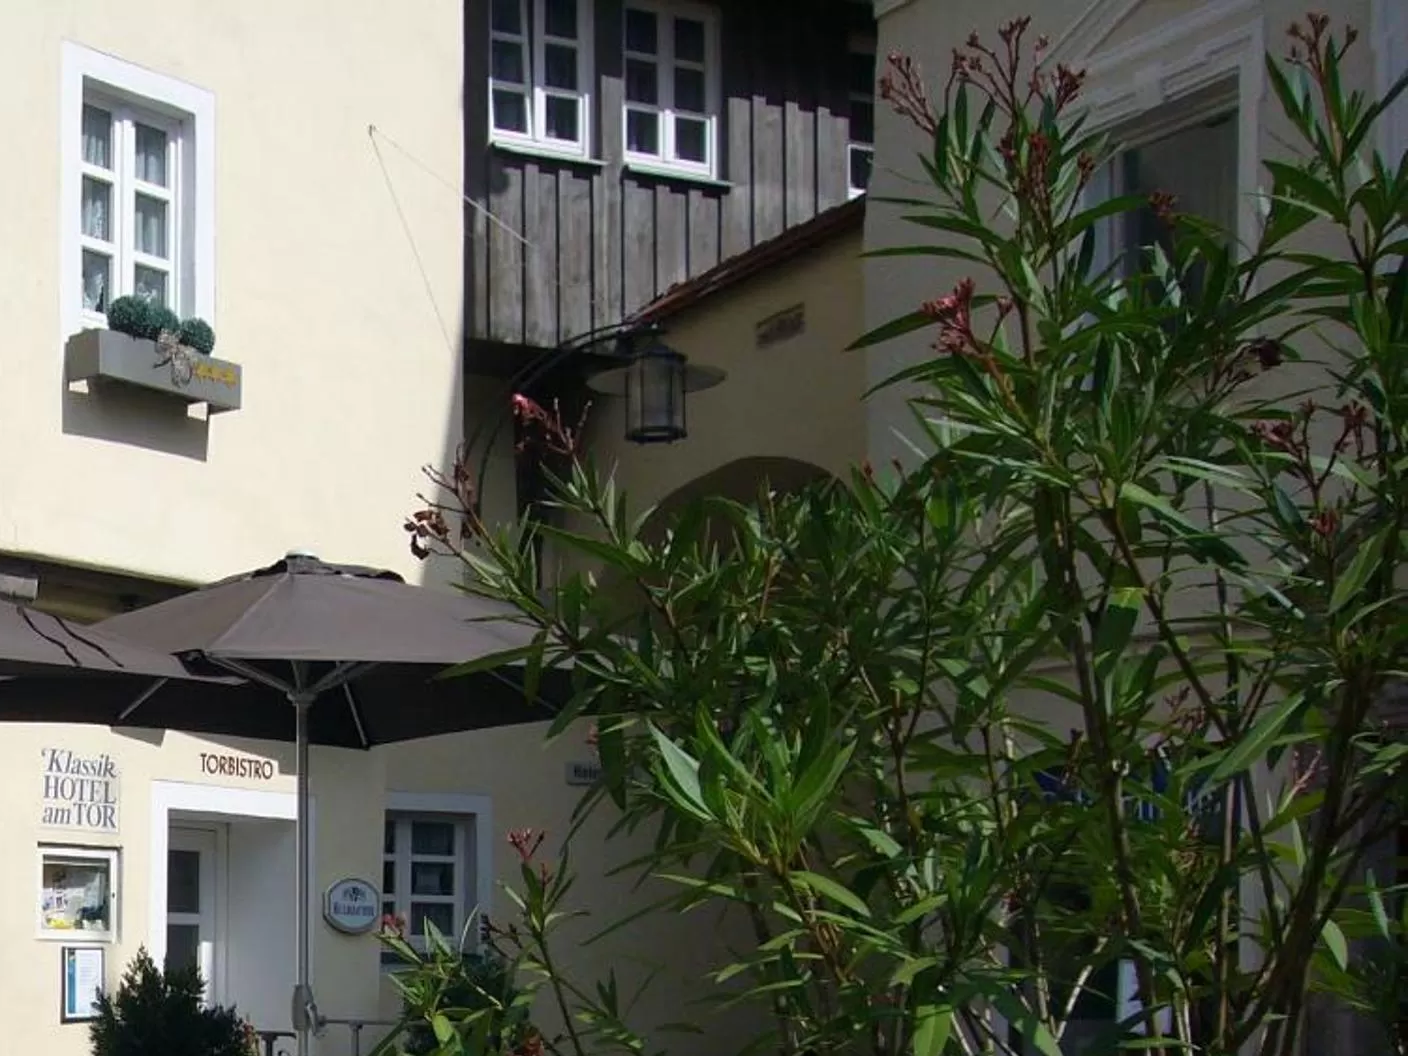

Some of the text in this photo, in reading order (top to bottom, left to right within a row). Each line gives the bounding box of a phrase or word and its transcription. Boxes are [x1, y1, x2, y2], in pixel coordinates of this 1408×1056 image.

[41, 748, 117, 779] Klassik
[200, 753, 273, 779] TORBISTRO
[43, 775, 117, 804] HOTEL
[42, 802, 117, 829] am TOR
